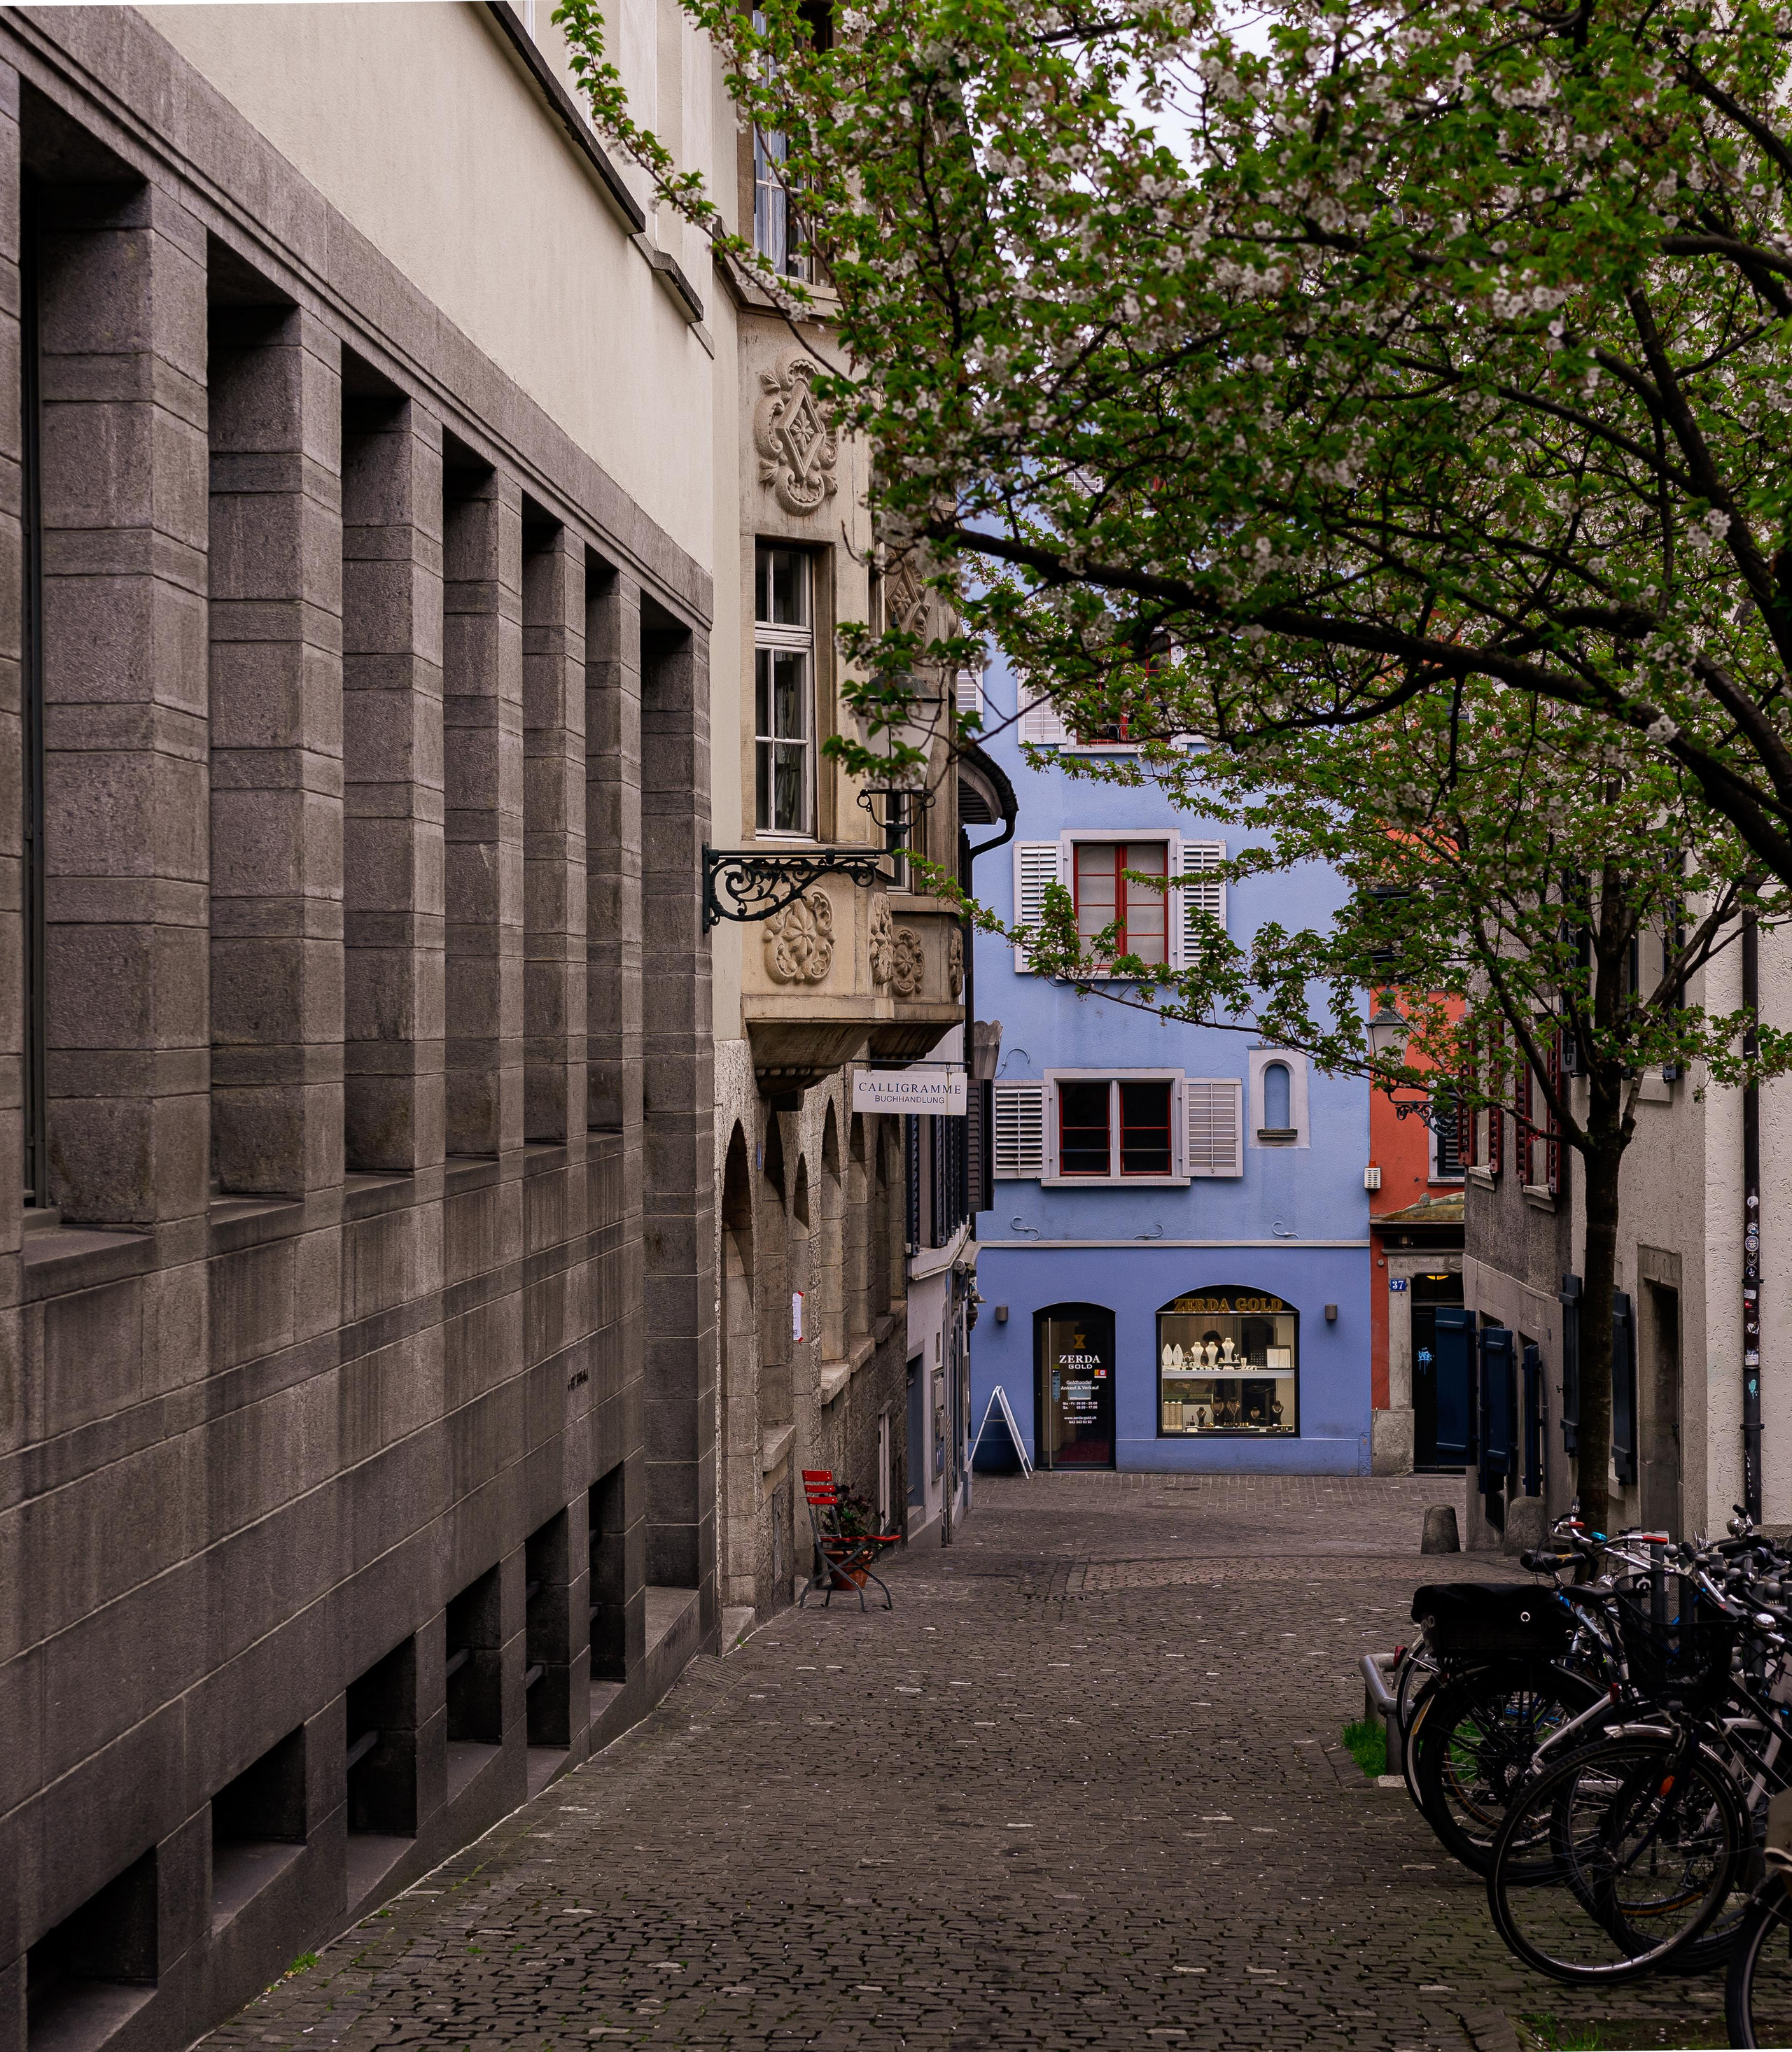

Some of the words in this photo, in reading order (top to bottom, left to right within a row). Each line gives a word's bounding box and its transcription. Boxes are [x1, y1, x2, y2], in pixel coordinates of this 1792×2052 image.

[858, 1082, 962, 1094] CALLIGRAMME
[874, 1095, 945, 1104] BUCHHANDLUNG
[1392, 1280, 1404, 1290] 37
[1174, 1298, 1231, 1312] ZERDA
[1235, 1298, 1283, 1312] GOLD
[1059, 1355, 1100, 1363] ZERDA
